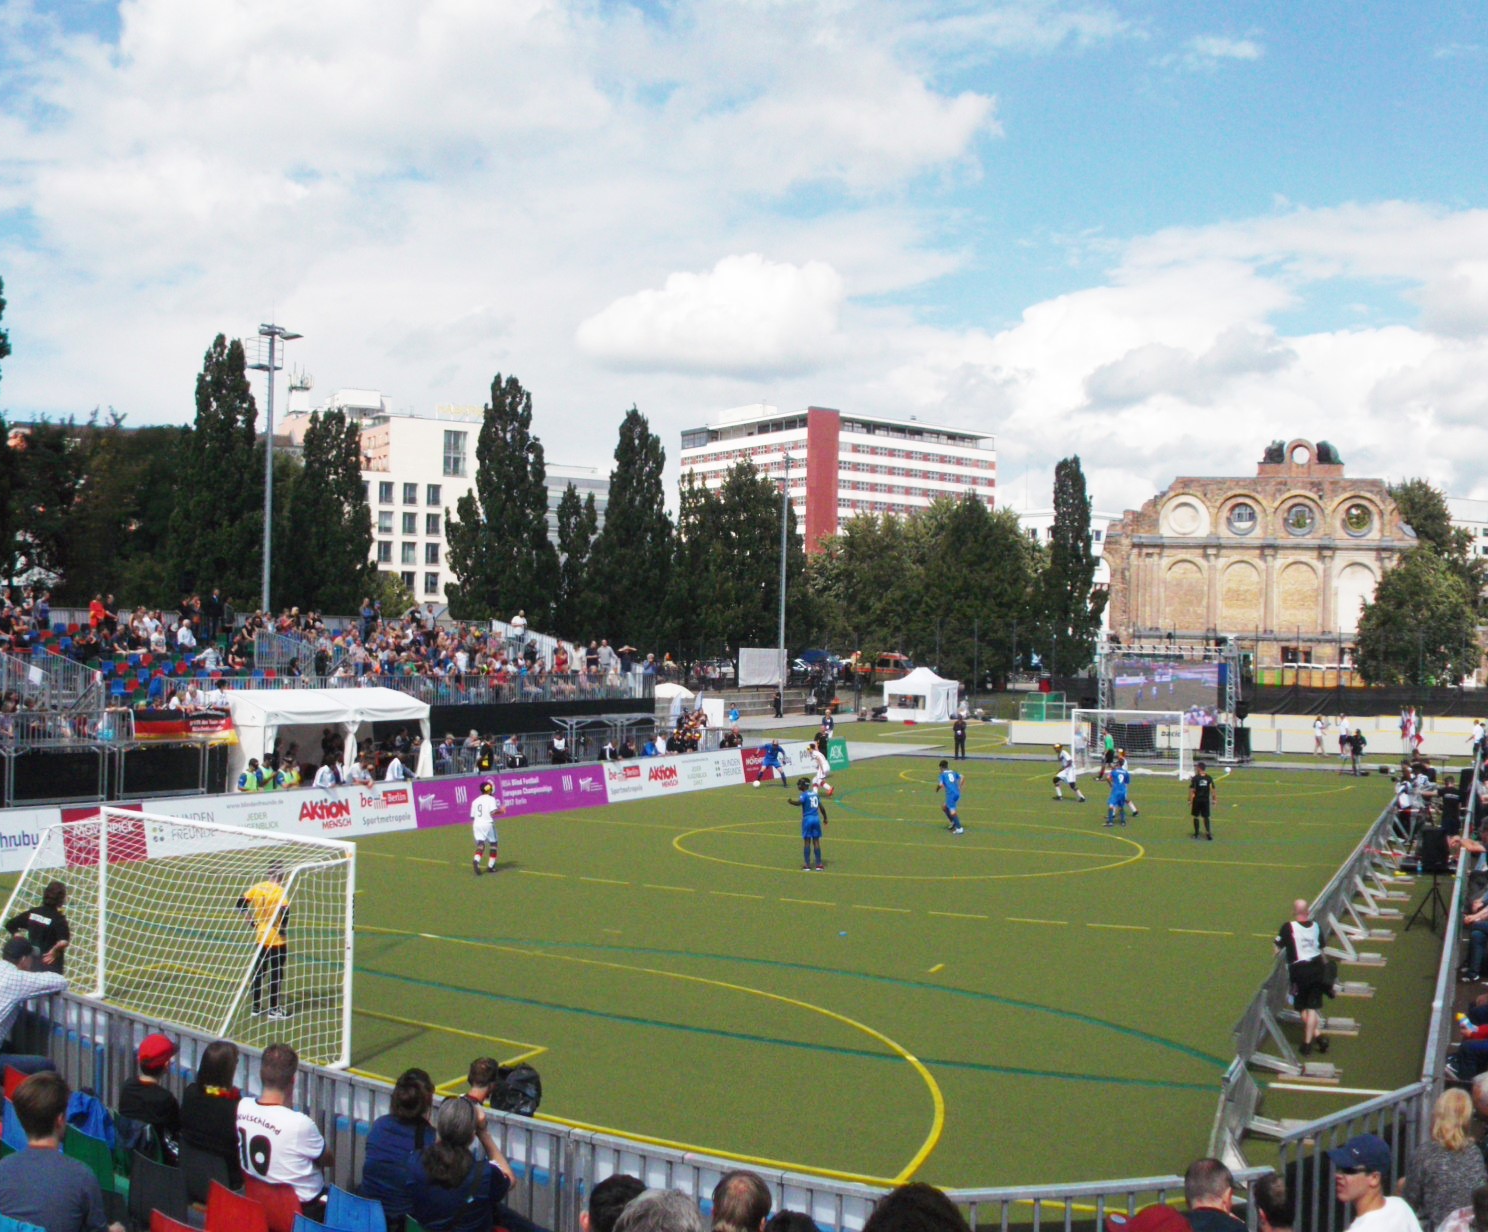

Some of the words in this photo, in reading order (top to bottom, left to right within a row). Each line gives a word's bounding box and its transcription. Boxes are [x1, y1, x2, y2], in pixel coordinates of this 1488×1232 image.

[1118, 773, 1125, 783] 9
[809, 795, 819, 808] 10
[477, 803, 483, 817] 9
[322, 817, 352, 830] MENSCH
[0, 830, 40, 850] hruby
[238, 1126, 272, 1177] 10
